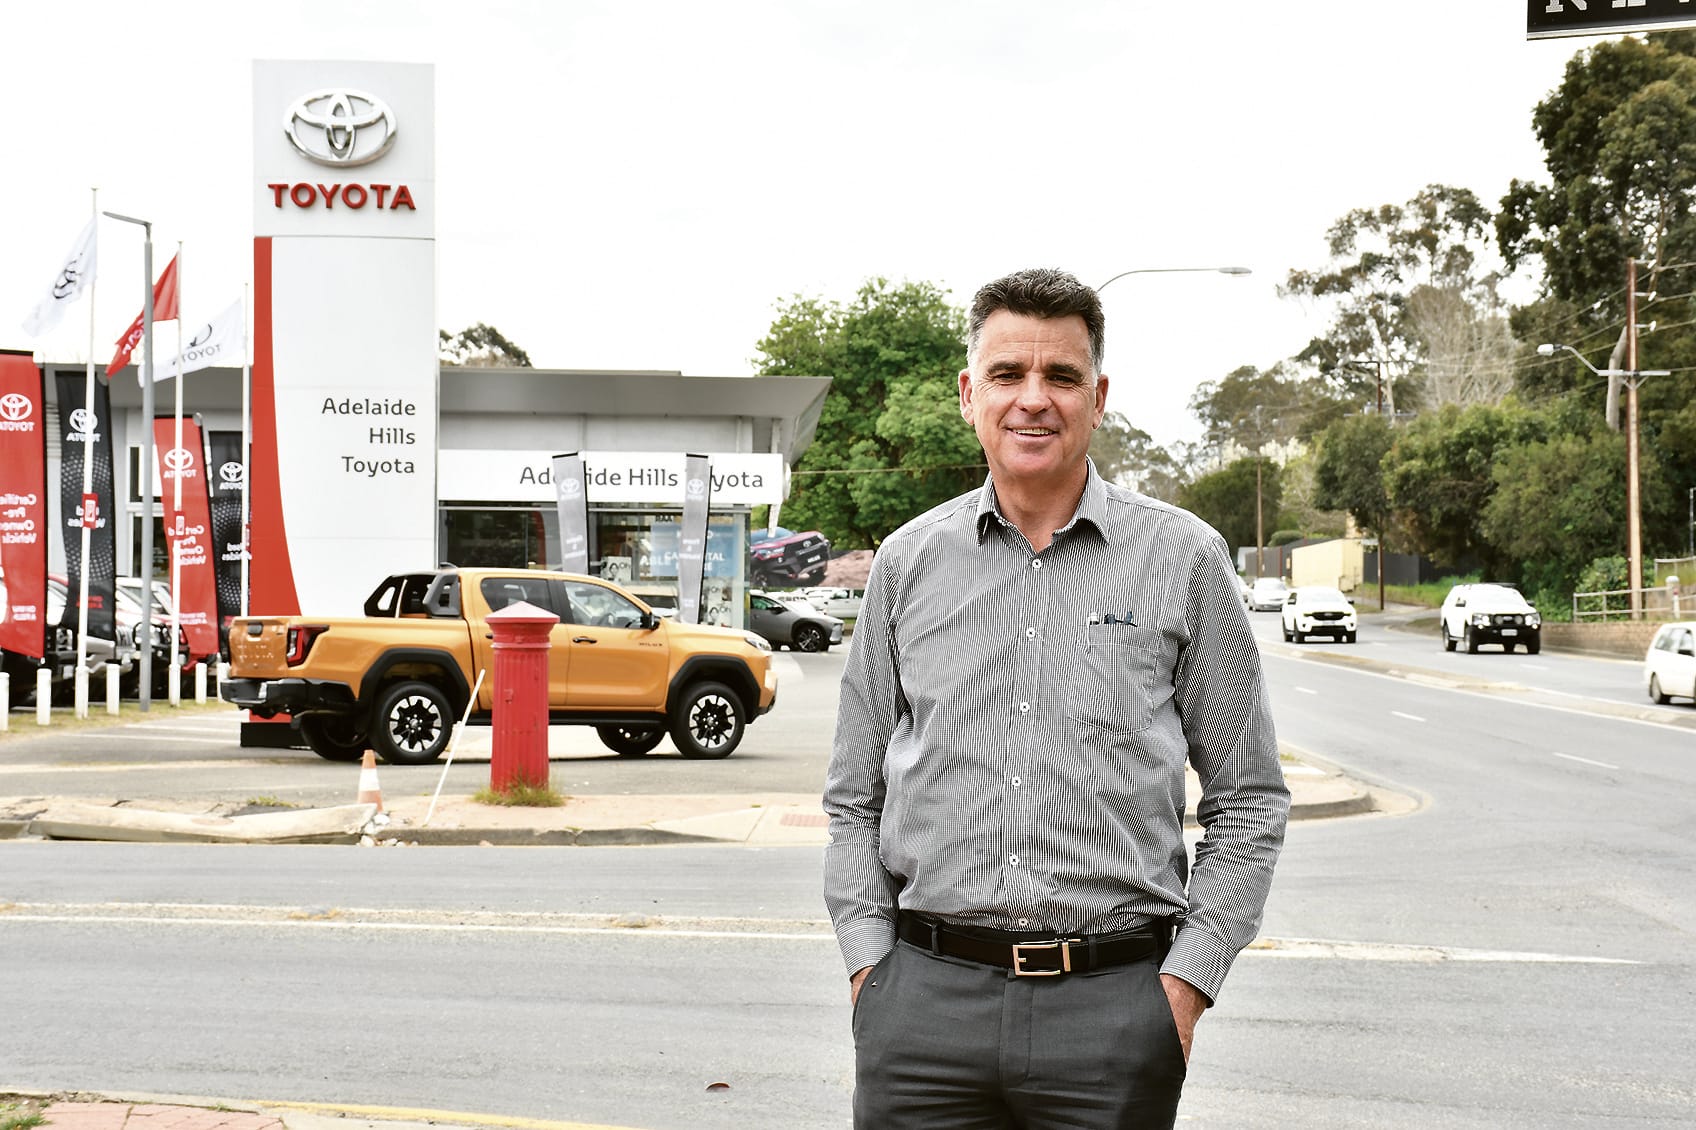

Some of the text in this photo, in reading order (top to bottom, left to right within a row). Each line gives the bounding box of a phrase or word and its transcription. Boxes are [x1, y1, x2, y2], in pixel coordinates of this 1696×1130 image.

[267, 182, 416, 210] TOYOTA
[322, 398, 416, 415] Adelaide
[369, 427, 416, 444] Hills
[341, 456, 415, 477] Toyota
[520, 466, 763, 492] Adide Hills yota
